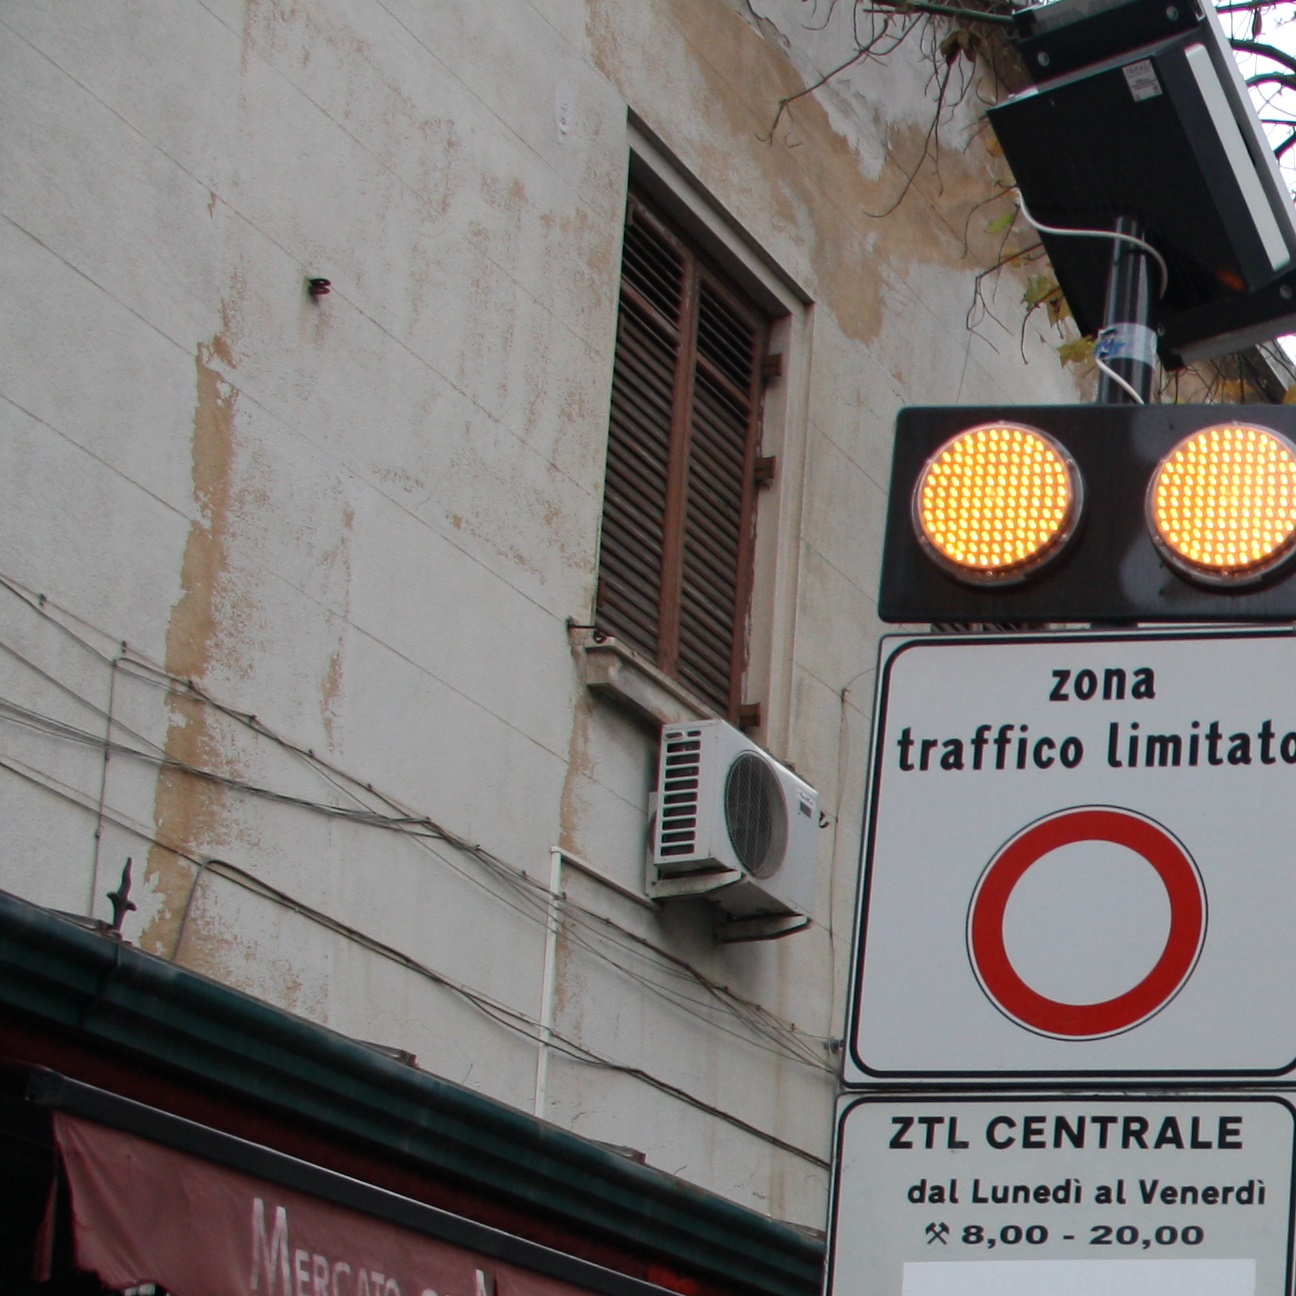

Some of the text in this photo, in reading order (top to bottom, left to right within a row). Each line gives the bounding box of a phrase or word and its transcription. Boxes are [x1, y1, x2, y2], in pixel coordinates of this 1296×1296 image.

[1049, 666, 1156, 702] zona
[897, 723, 1084, 772] traffico
[888, 1115, 1244, 1150] ZTL CENTRALE
[907, 1177, 1267, 1206] dal Lunedì al Venerdì
[961, 1224, 1049, 1248] 8,00
[1088, 1225, 1205, 1250] 20,00
